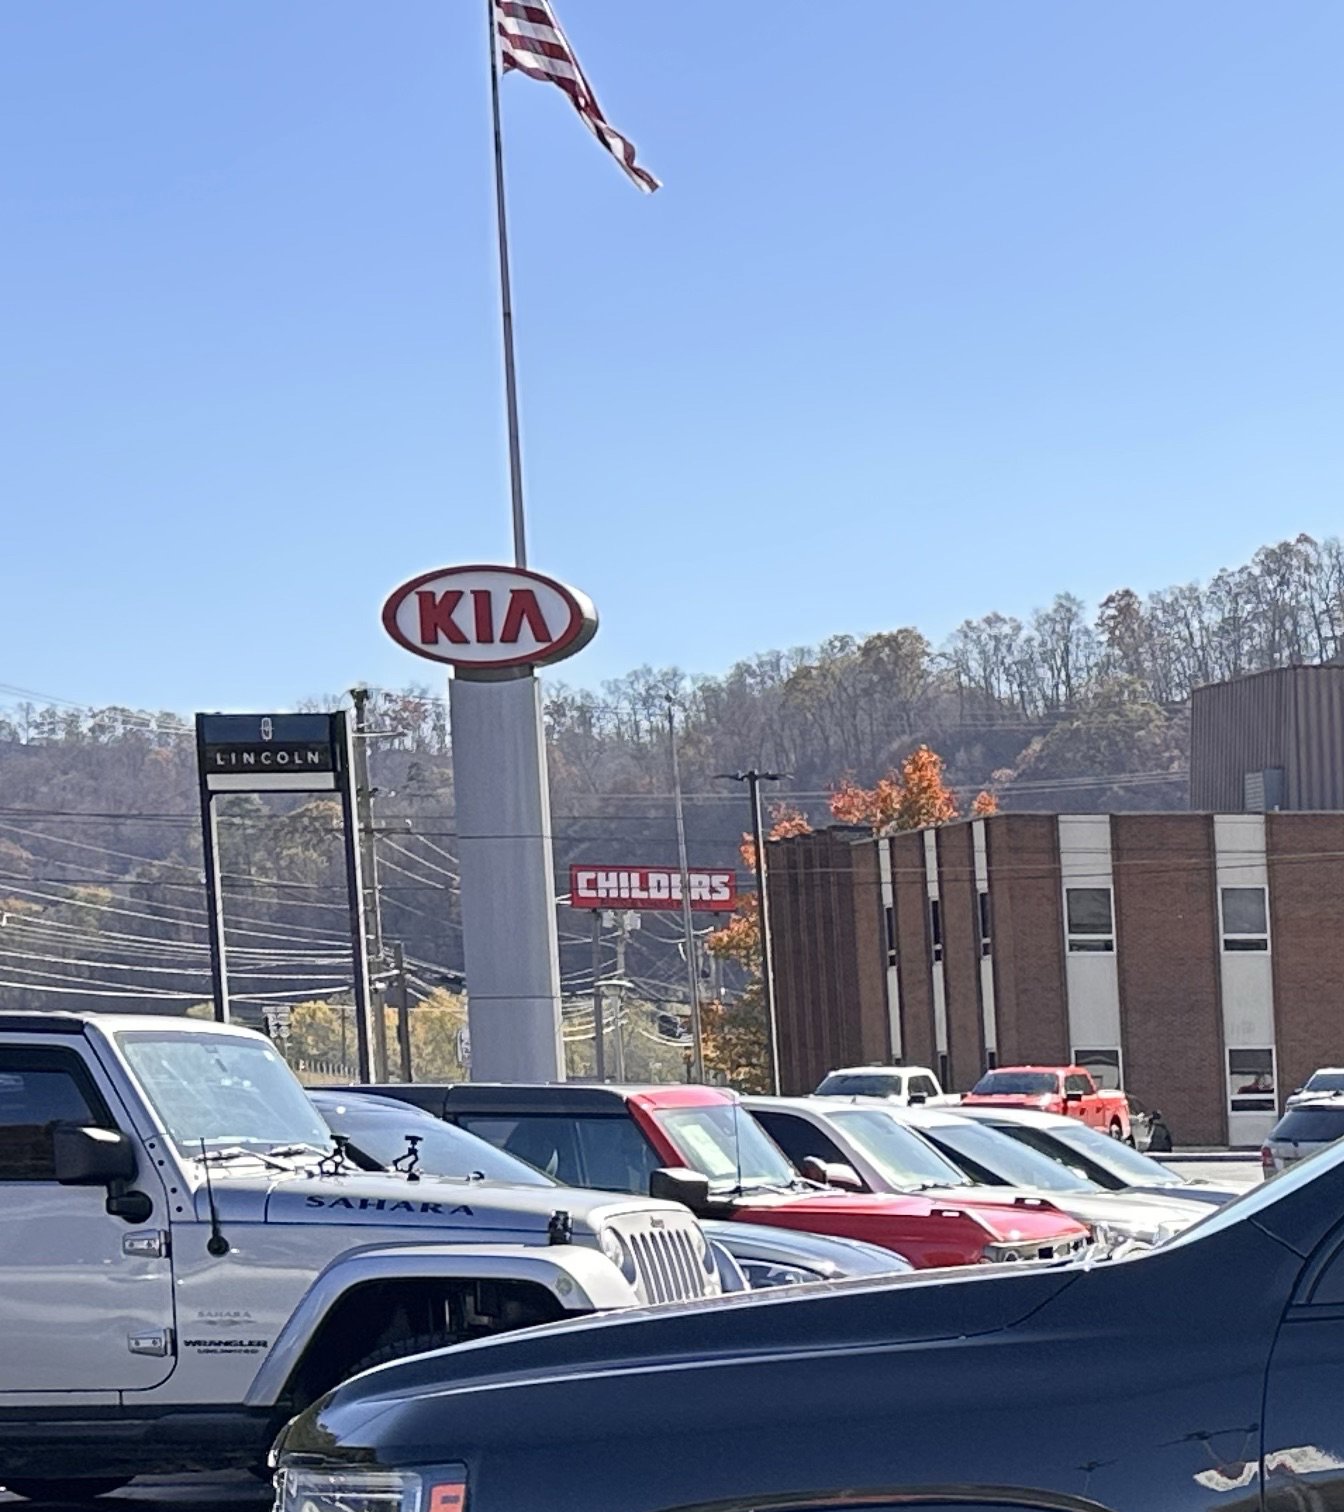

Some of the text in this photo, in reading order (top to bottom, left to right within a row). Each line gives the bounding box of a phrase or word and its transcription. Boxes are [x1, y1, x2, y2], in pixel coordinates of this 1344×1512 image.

[415, 589, 553, 644] KIA
[215, 751, 320, 766] LINCOLN
[305, 1195, 475, 1217] SAHARA
